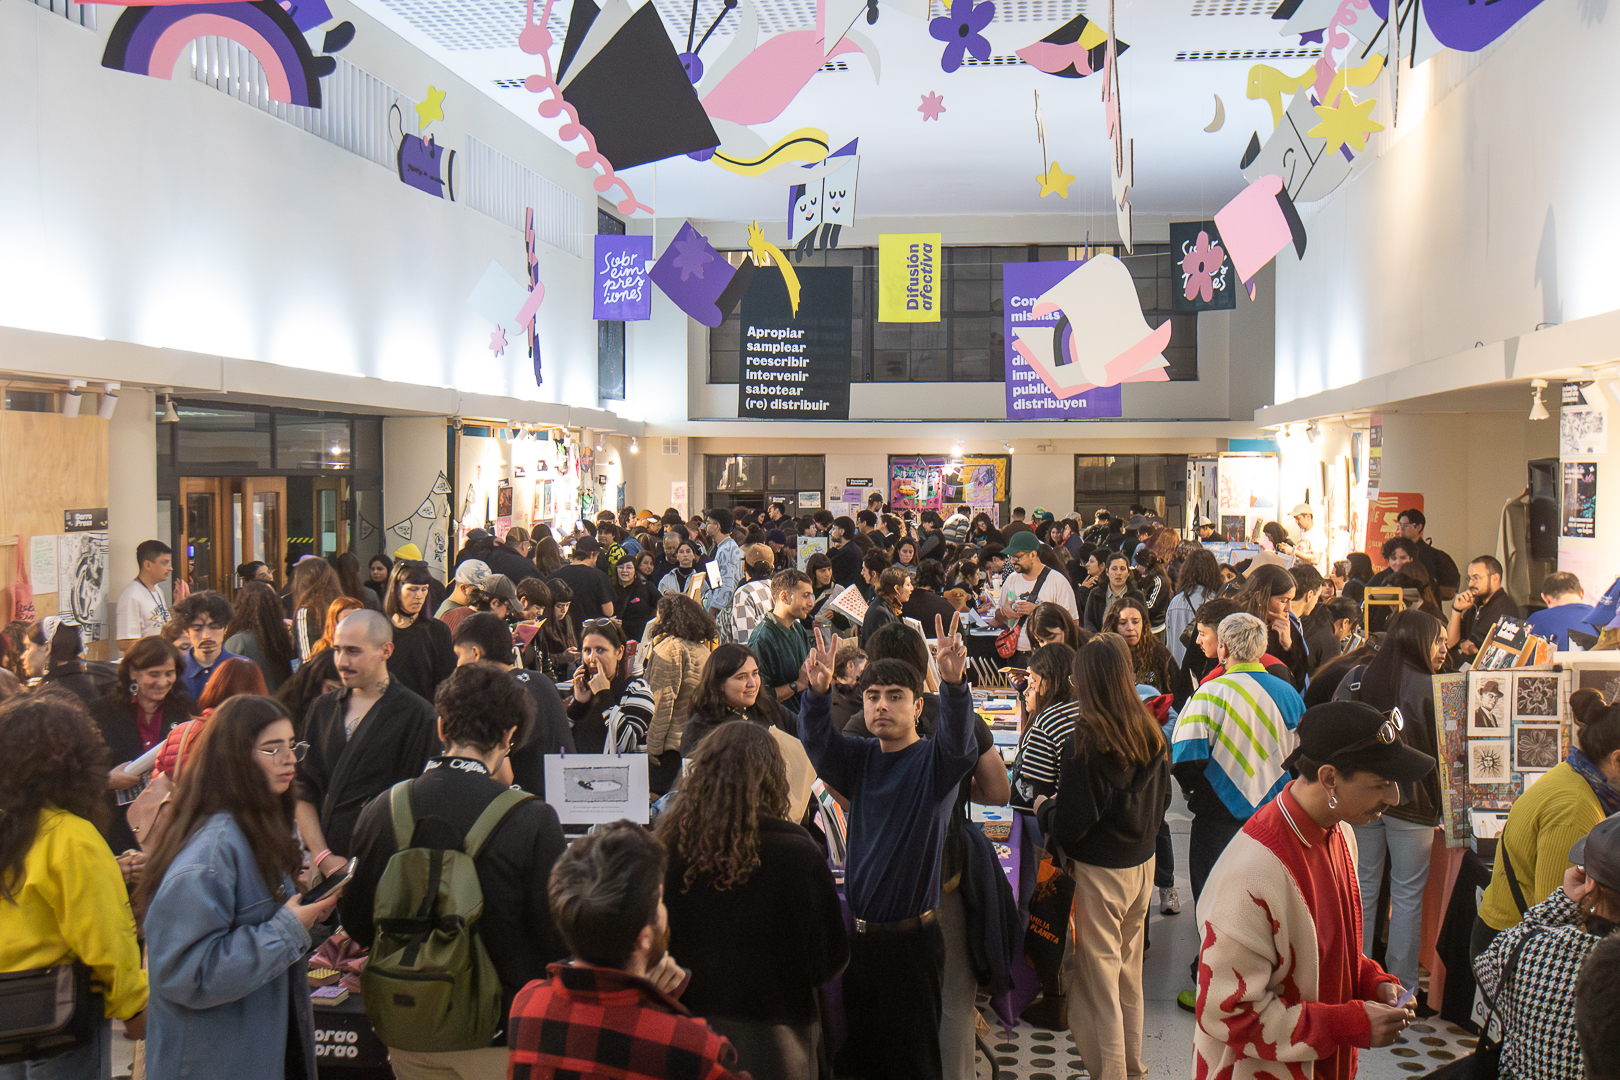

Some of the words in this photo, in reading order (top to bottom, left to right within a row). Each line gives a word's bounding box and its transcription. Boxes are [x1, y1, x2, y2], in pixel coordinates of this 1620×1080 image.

[906, 244, 919, 310] Difusión
[920, 243, 933, 310] afectiva
[746, 325, 805, 340] Apropiar
[746, 341, 807, 354] samplear
[746, 356, 810, 368] reescribir
[745, 368, 810, 382] intervenir
[745, 383, 804, 396] sabotear
[1012, 383, 1053, 397] public
[745, 397, 768, 411] (re)
[770, 399, 830, 411] distribuir
[1013, 398, 1087, 410] distribuyen
[1030, 923, 1060, 945] PLANETA
